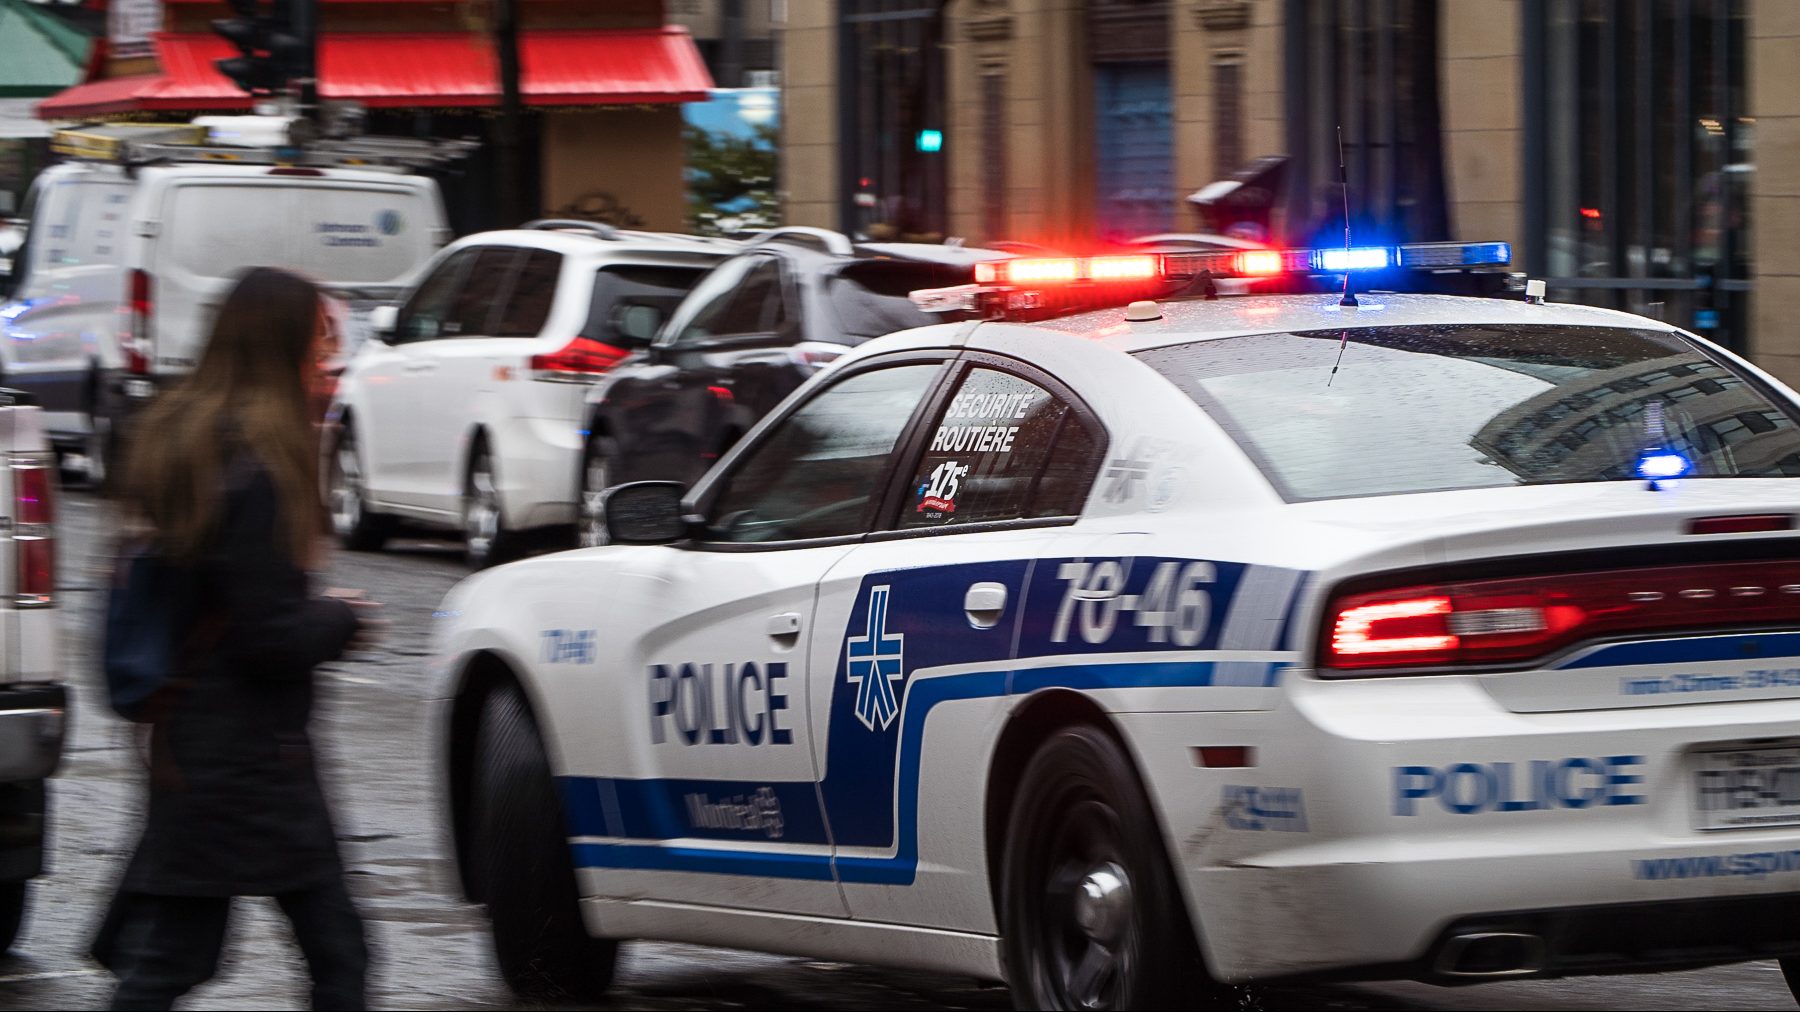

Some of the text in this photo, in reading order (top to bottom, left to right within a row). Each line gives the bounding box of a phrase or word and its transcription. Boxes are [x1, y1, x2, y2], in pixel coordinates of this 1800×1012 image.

[944, 387, 1035, 419] SÉCURITÉ
[929, 420, 1020, 452] ROUTIÈRE
[1049, 560, 1218, 647] 70-46
[648, 661, 793, 746] POLICE
[1391, 755, 1648, 816] POLICE
